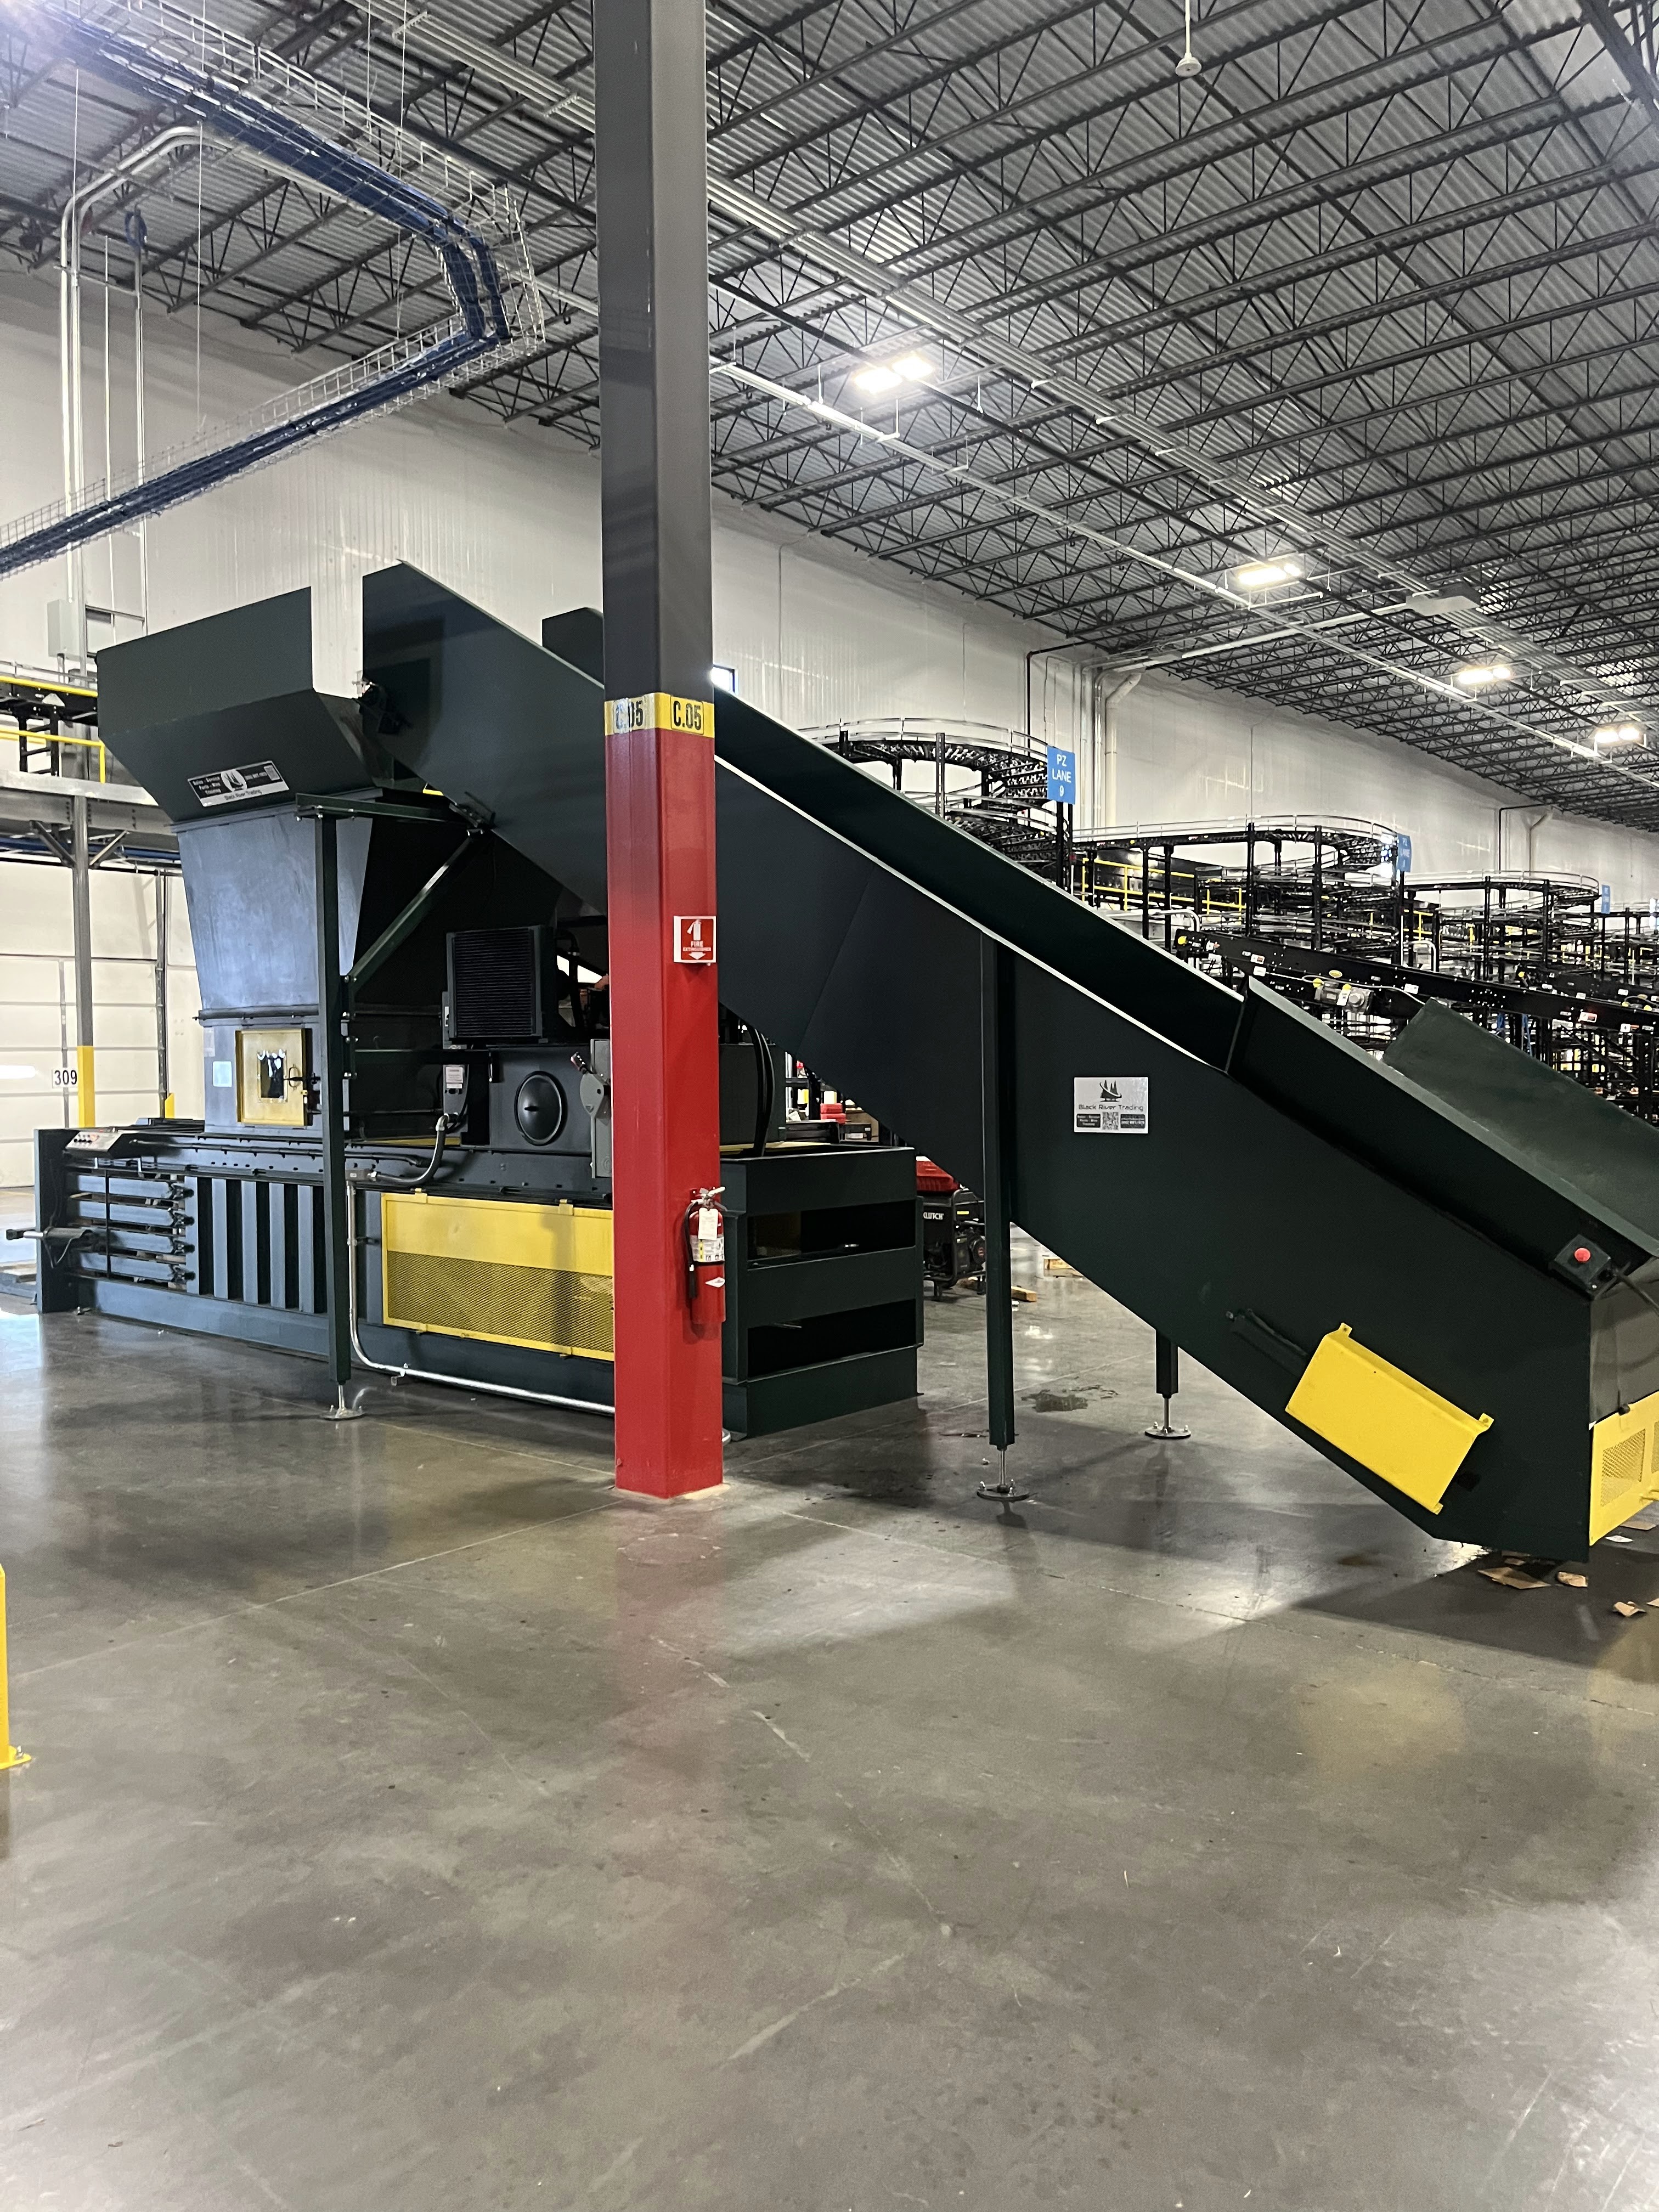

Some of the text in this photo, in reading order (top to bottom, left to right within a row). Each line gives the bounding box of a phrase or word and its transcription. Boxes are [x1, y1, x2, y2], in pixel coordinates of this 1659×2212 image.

[673, 701, 702, 731] C.05
[1057, 754, 1067, 766] PZ
[1052, 768, 1071, 783] LANE
[54, 1070, 77, 1086] 309
